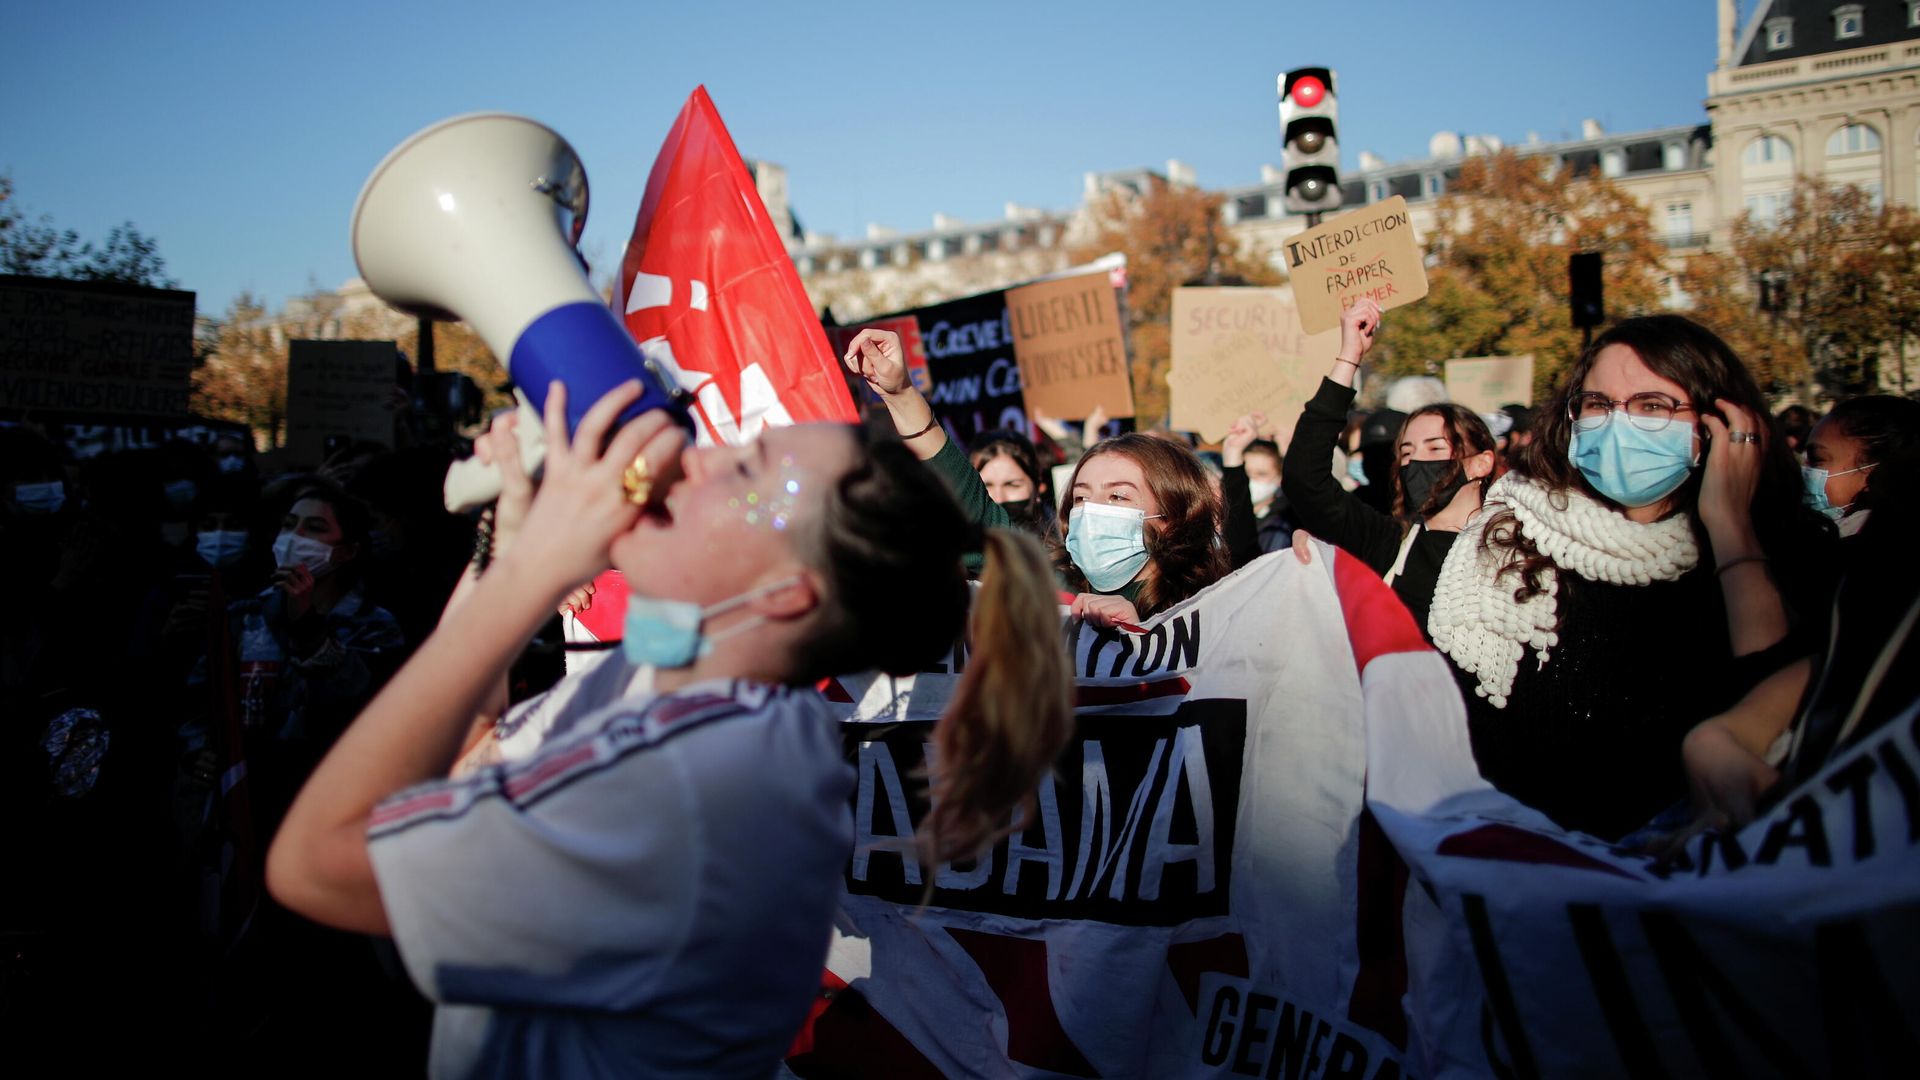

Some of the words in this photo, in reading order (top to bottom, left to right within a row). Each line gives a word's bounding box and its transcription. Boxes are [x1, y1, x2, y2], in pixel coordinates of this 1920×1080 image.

[1287, 212, 1407, 268] INTERDICTION
[1339, 252, 1358, 267] DE
[1326, 259, 1393, 294] FRAPPER
[1340, 283, 1399, 311] FIMER
[1187, 303, 1298, 336] SECURIT
